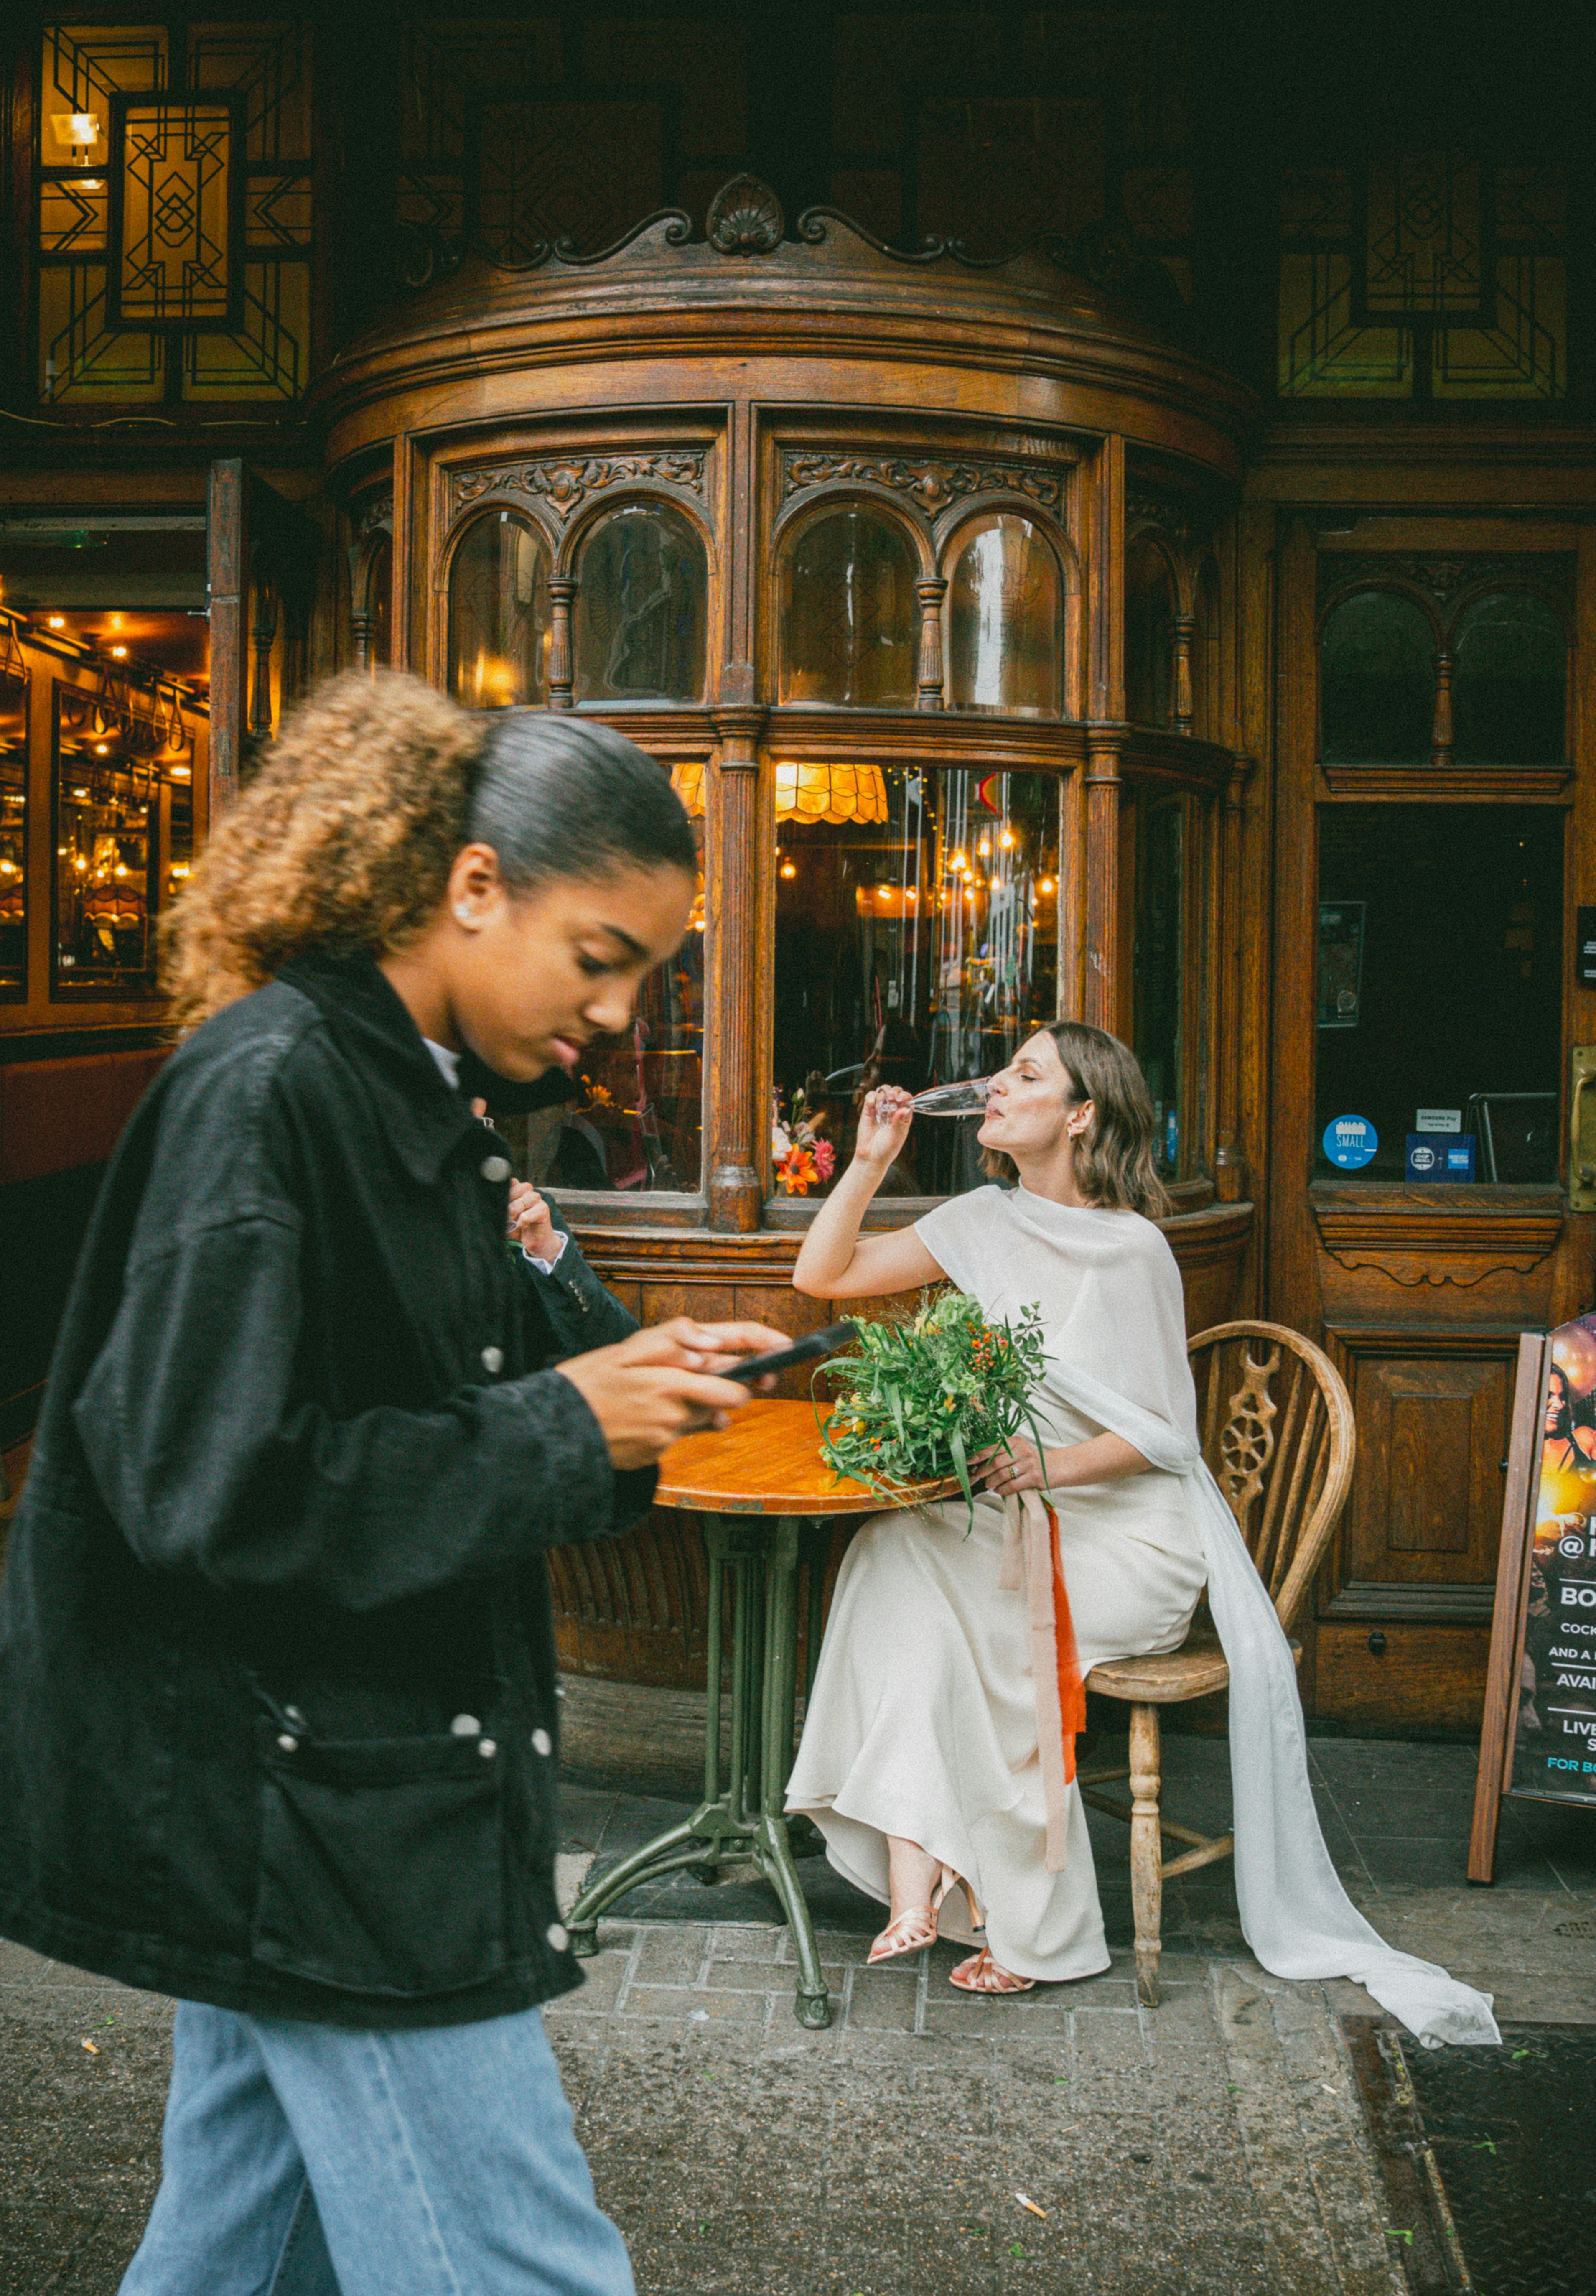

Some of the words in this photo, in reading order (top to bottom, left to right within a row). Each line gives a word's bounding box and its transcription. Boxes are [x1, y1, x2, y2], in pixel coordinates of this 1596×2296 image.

[1336, 1134, 1364, 1147] SMALL
[1561, 1587, 1596, 1607] BO
[1549, 1647, 1578, 1659] AND
[1581, 1650, 1591, 1660] A
[1563, 1720, 1596, 1736] LIVE
[1548, 1757, 1578, 1771] FOR
